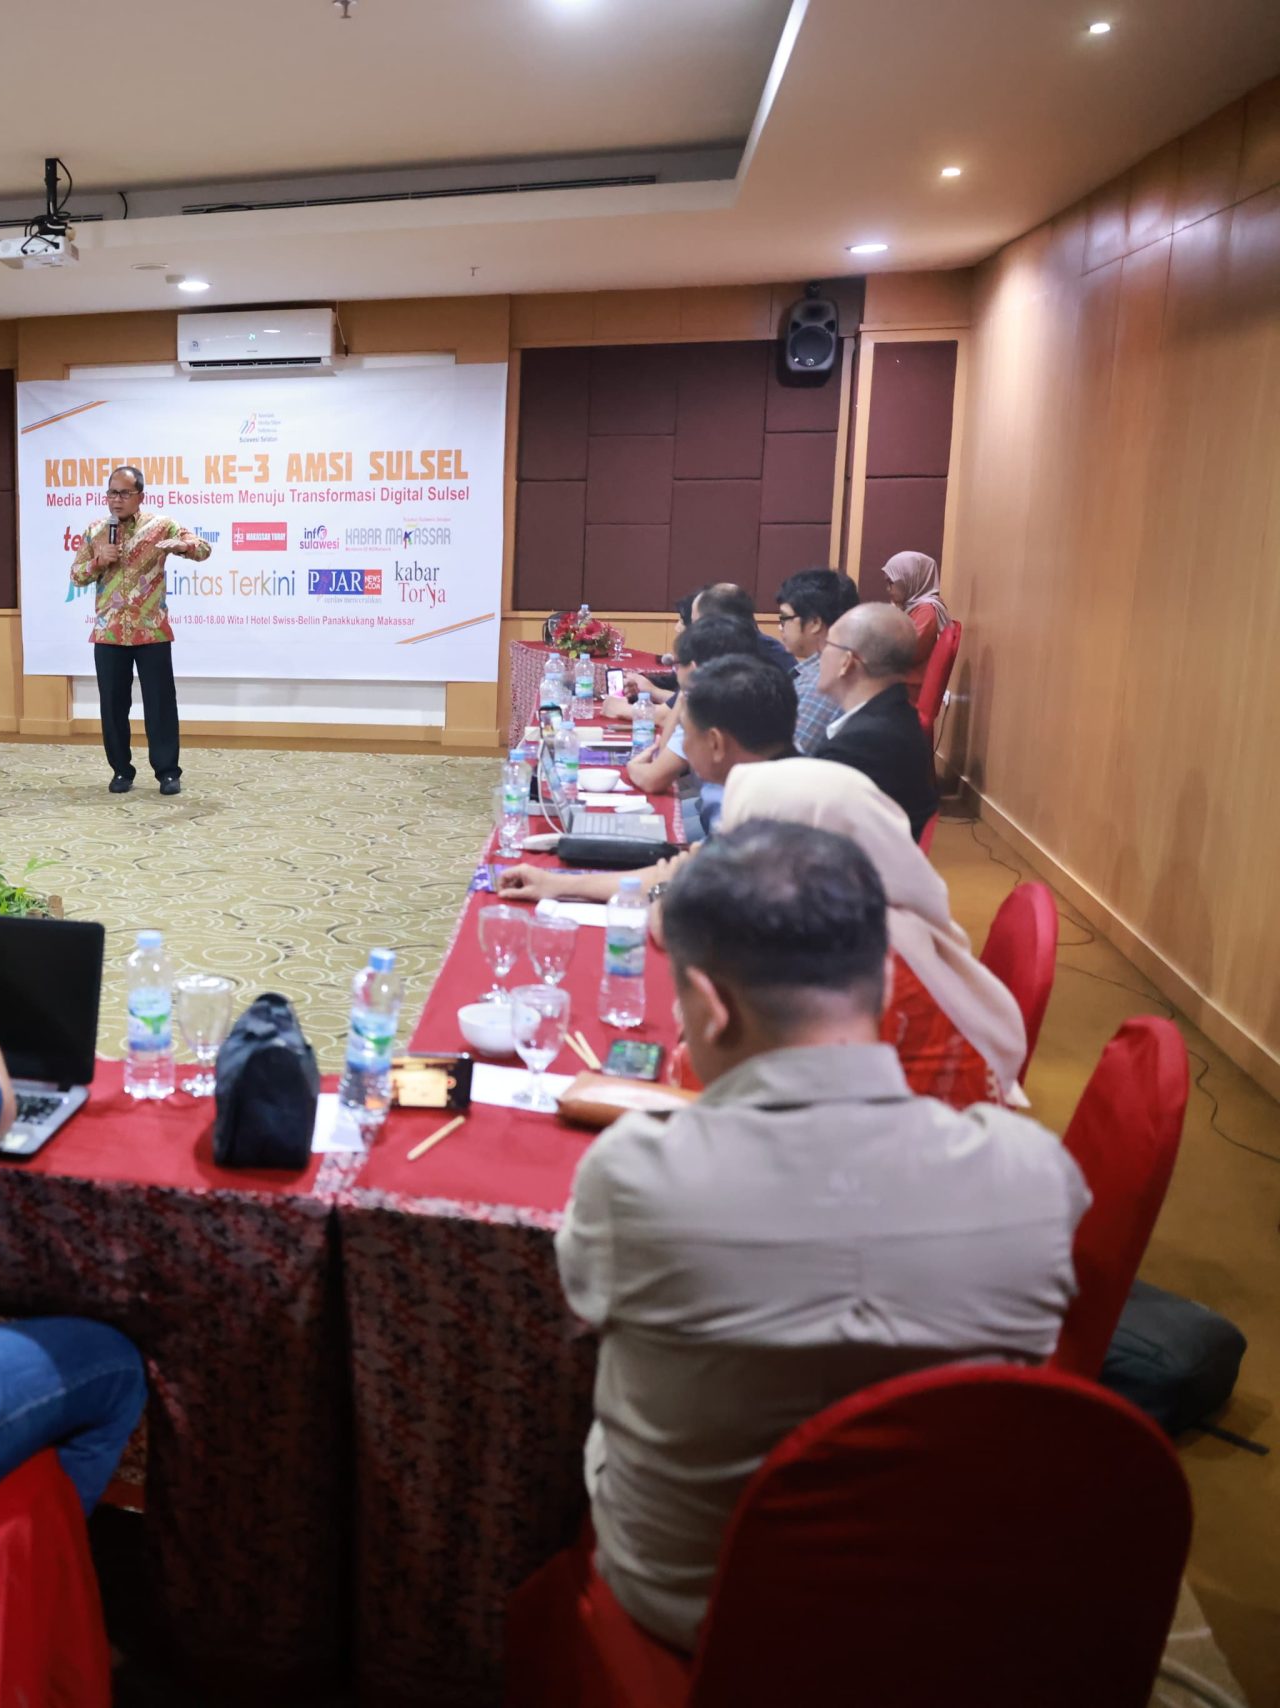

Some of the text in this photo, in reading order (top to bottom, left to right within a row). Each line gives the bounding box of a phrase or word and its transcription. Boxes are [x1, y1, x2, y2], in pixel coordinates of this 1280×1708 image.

[204, 454, 269, 484] KE-3
[286, 452, 352, 482] AMSI
[369, 449, 468, 481] SULSEL
[46, 493, 81, 507] Media
[86, 492, 109, 506] Pila
[169, 490, 234, 505] Ekosistem
[238, 489, 285, 507] Menuju
[289, 488, 376, 503] Transformasi
[380, 486, 423, 505] Digital
[427, 486, 470, 501] Sulsel
[299, 537, 340, 550] sulawesi
[345, 527, 452, 548] KABAR MAKASSAR
[364, 575, 381, 583] NEWS
[395, 560, 440, 581] kabar
[163, 570, 296, 596] Lintas Terkini
[184, 615, 226, 625] 13.00-18.00
[227, 615, 244, 625] Wita
[250, 615, 271, 625] Hotel
[322, 616, 374, 628] Panakkukang
[377, 616, 415, 626] Makassar
